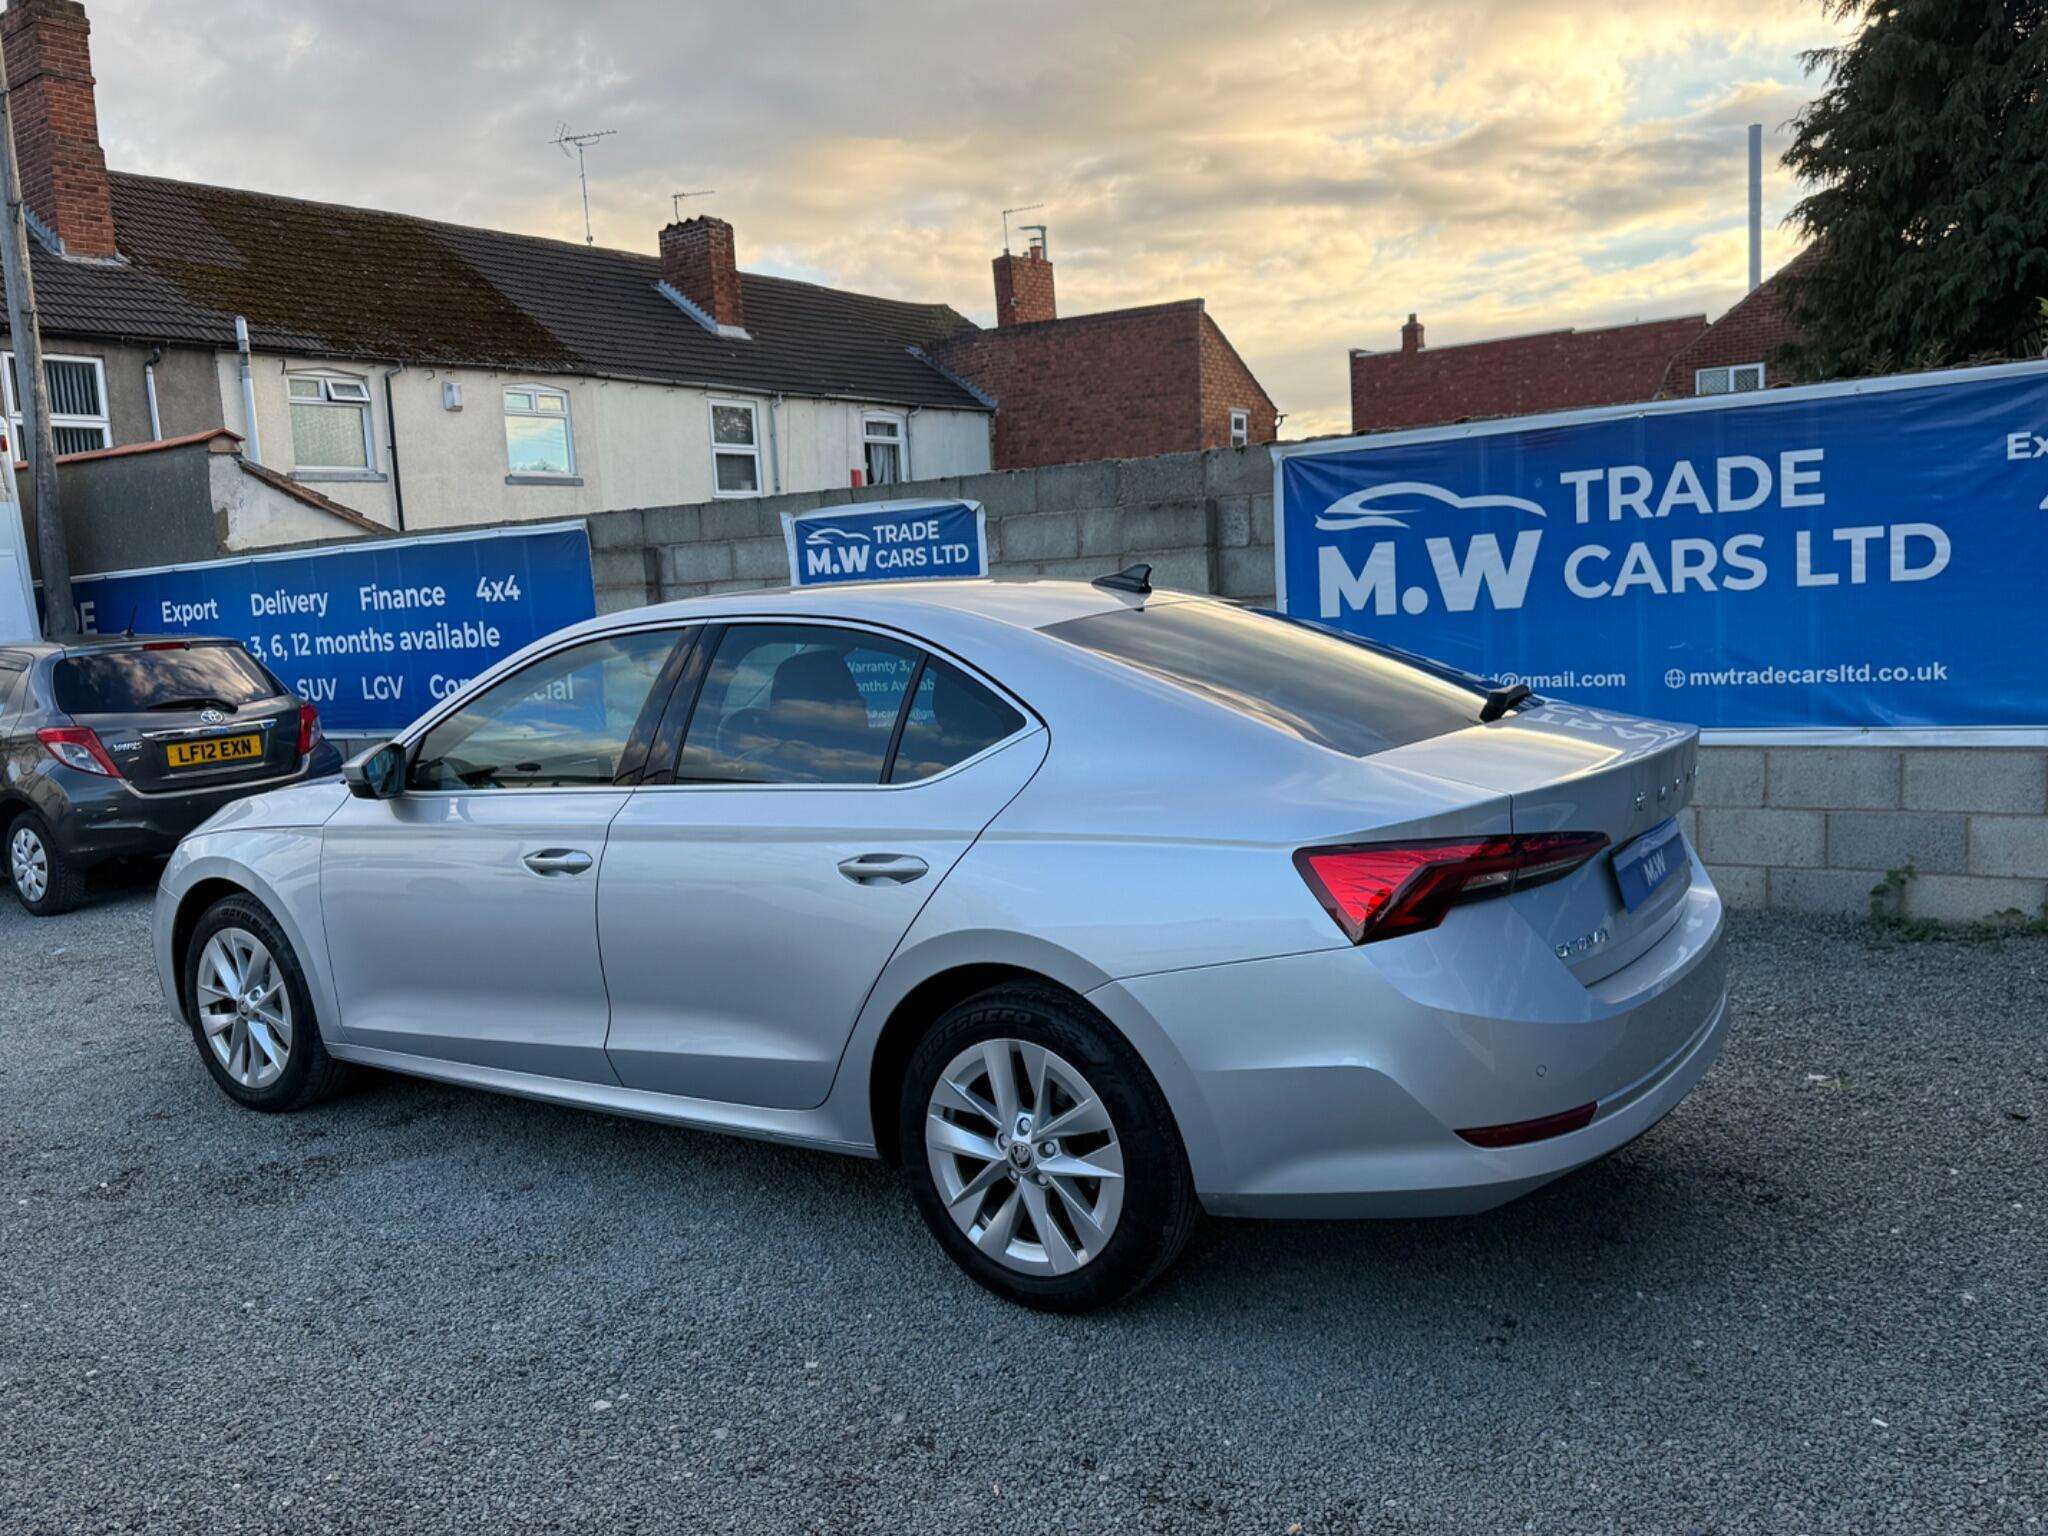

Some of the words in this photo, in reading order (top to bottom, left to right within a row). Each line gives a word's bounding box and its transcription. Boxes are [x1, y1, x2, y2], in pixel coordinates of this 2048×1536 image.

[1560, 448, 1825, 524] TRADE
[872, 520, 940, 544] TRADE
[806, 544, 870, 576] M.W
[875, 546, 927, 569] CARS
[932, 543, 970, 565] LTD
[1563, 533, 1768, 599] CARS
[1796, 522, 1952, 588] LTD
[1317, 529, 1543, 619] M.W
[161, 599, 219, 627] Export
[250, 589, 328, 618] Delivery
[359, 584, 446, 611] Finance
[476, 575, 522, 602] 4x4
[250, 635, 268, 662] 3,
[271, 633, 289, 661] 6,
[290, 632, 311, 656] 12
[315, 627, 395, 655] months
[399, 621, 500, 650] available
[297, 678, 337, 702] SUV
[362, 676, 403, 700] LGV
[1690, 661, 1948, 686] mwtradecarsltd.co.uk
[178, 743, 217, 763] LF12
[220, 739, 252, 757] EXN
